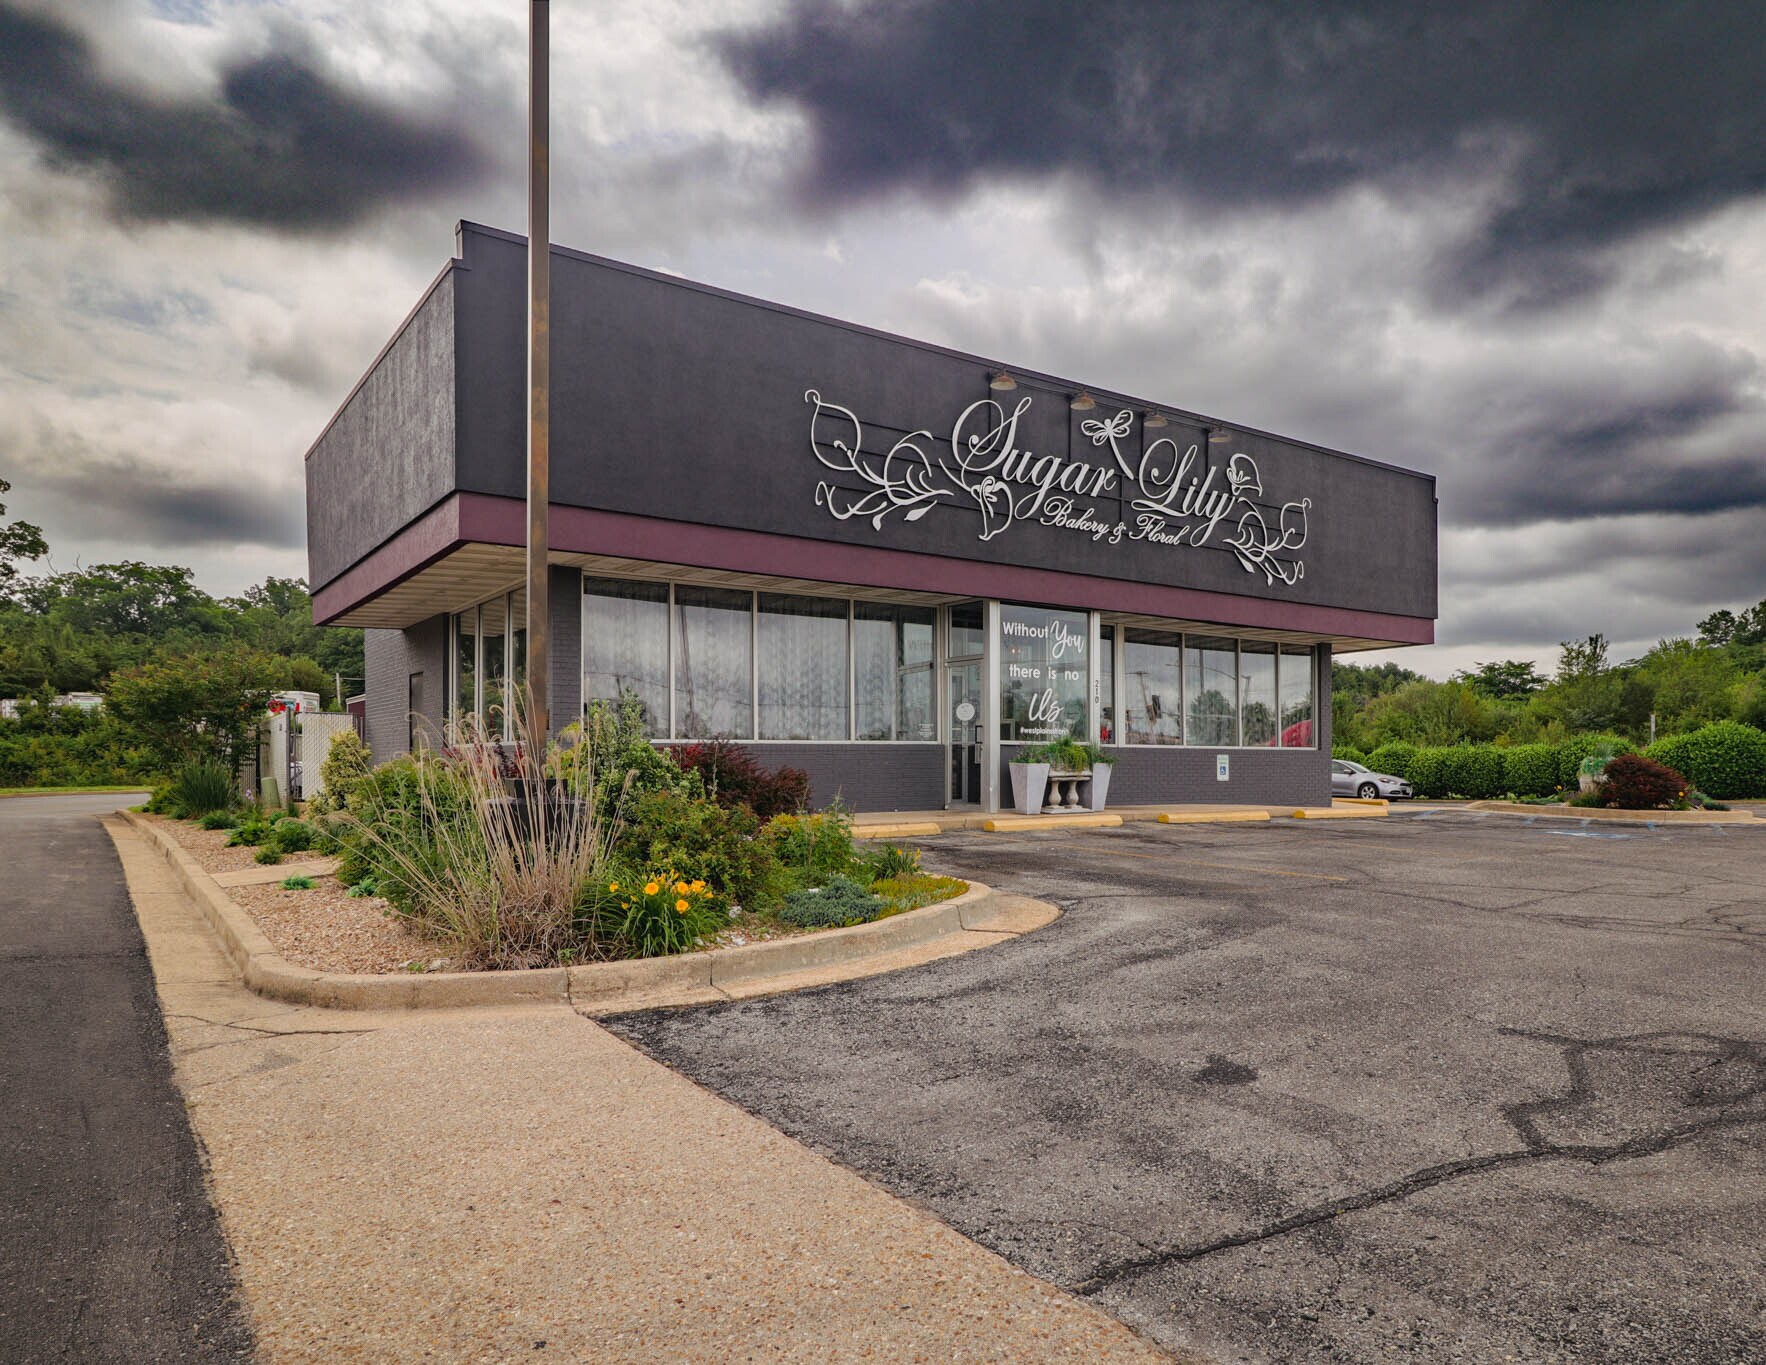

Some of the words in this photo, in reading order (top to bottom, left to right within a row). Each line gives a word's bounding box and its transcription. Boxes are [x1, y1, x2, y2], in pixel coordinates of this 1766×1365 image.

[952, 397, 1117, 519] Sugar
[1131, 438, 1235, 547] Lily
[1040, 496, 1110, 541] Bakery
[1108, 521, 1127, 544] &
[1129, 513, 1190, 546] Floral
[1002, 621, 1049, 639] Without
[1050, 620, 1085, 659] You
[1009, 664, 1041, 679] there
[1048, 666, 1057, 680] is
[1064, 670, 1080, 681] no
[1028, 688, 1065, 723] Us
